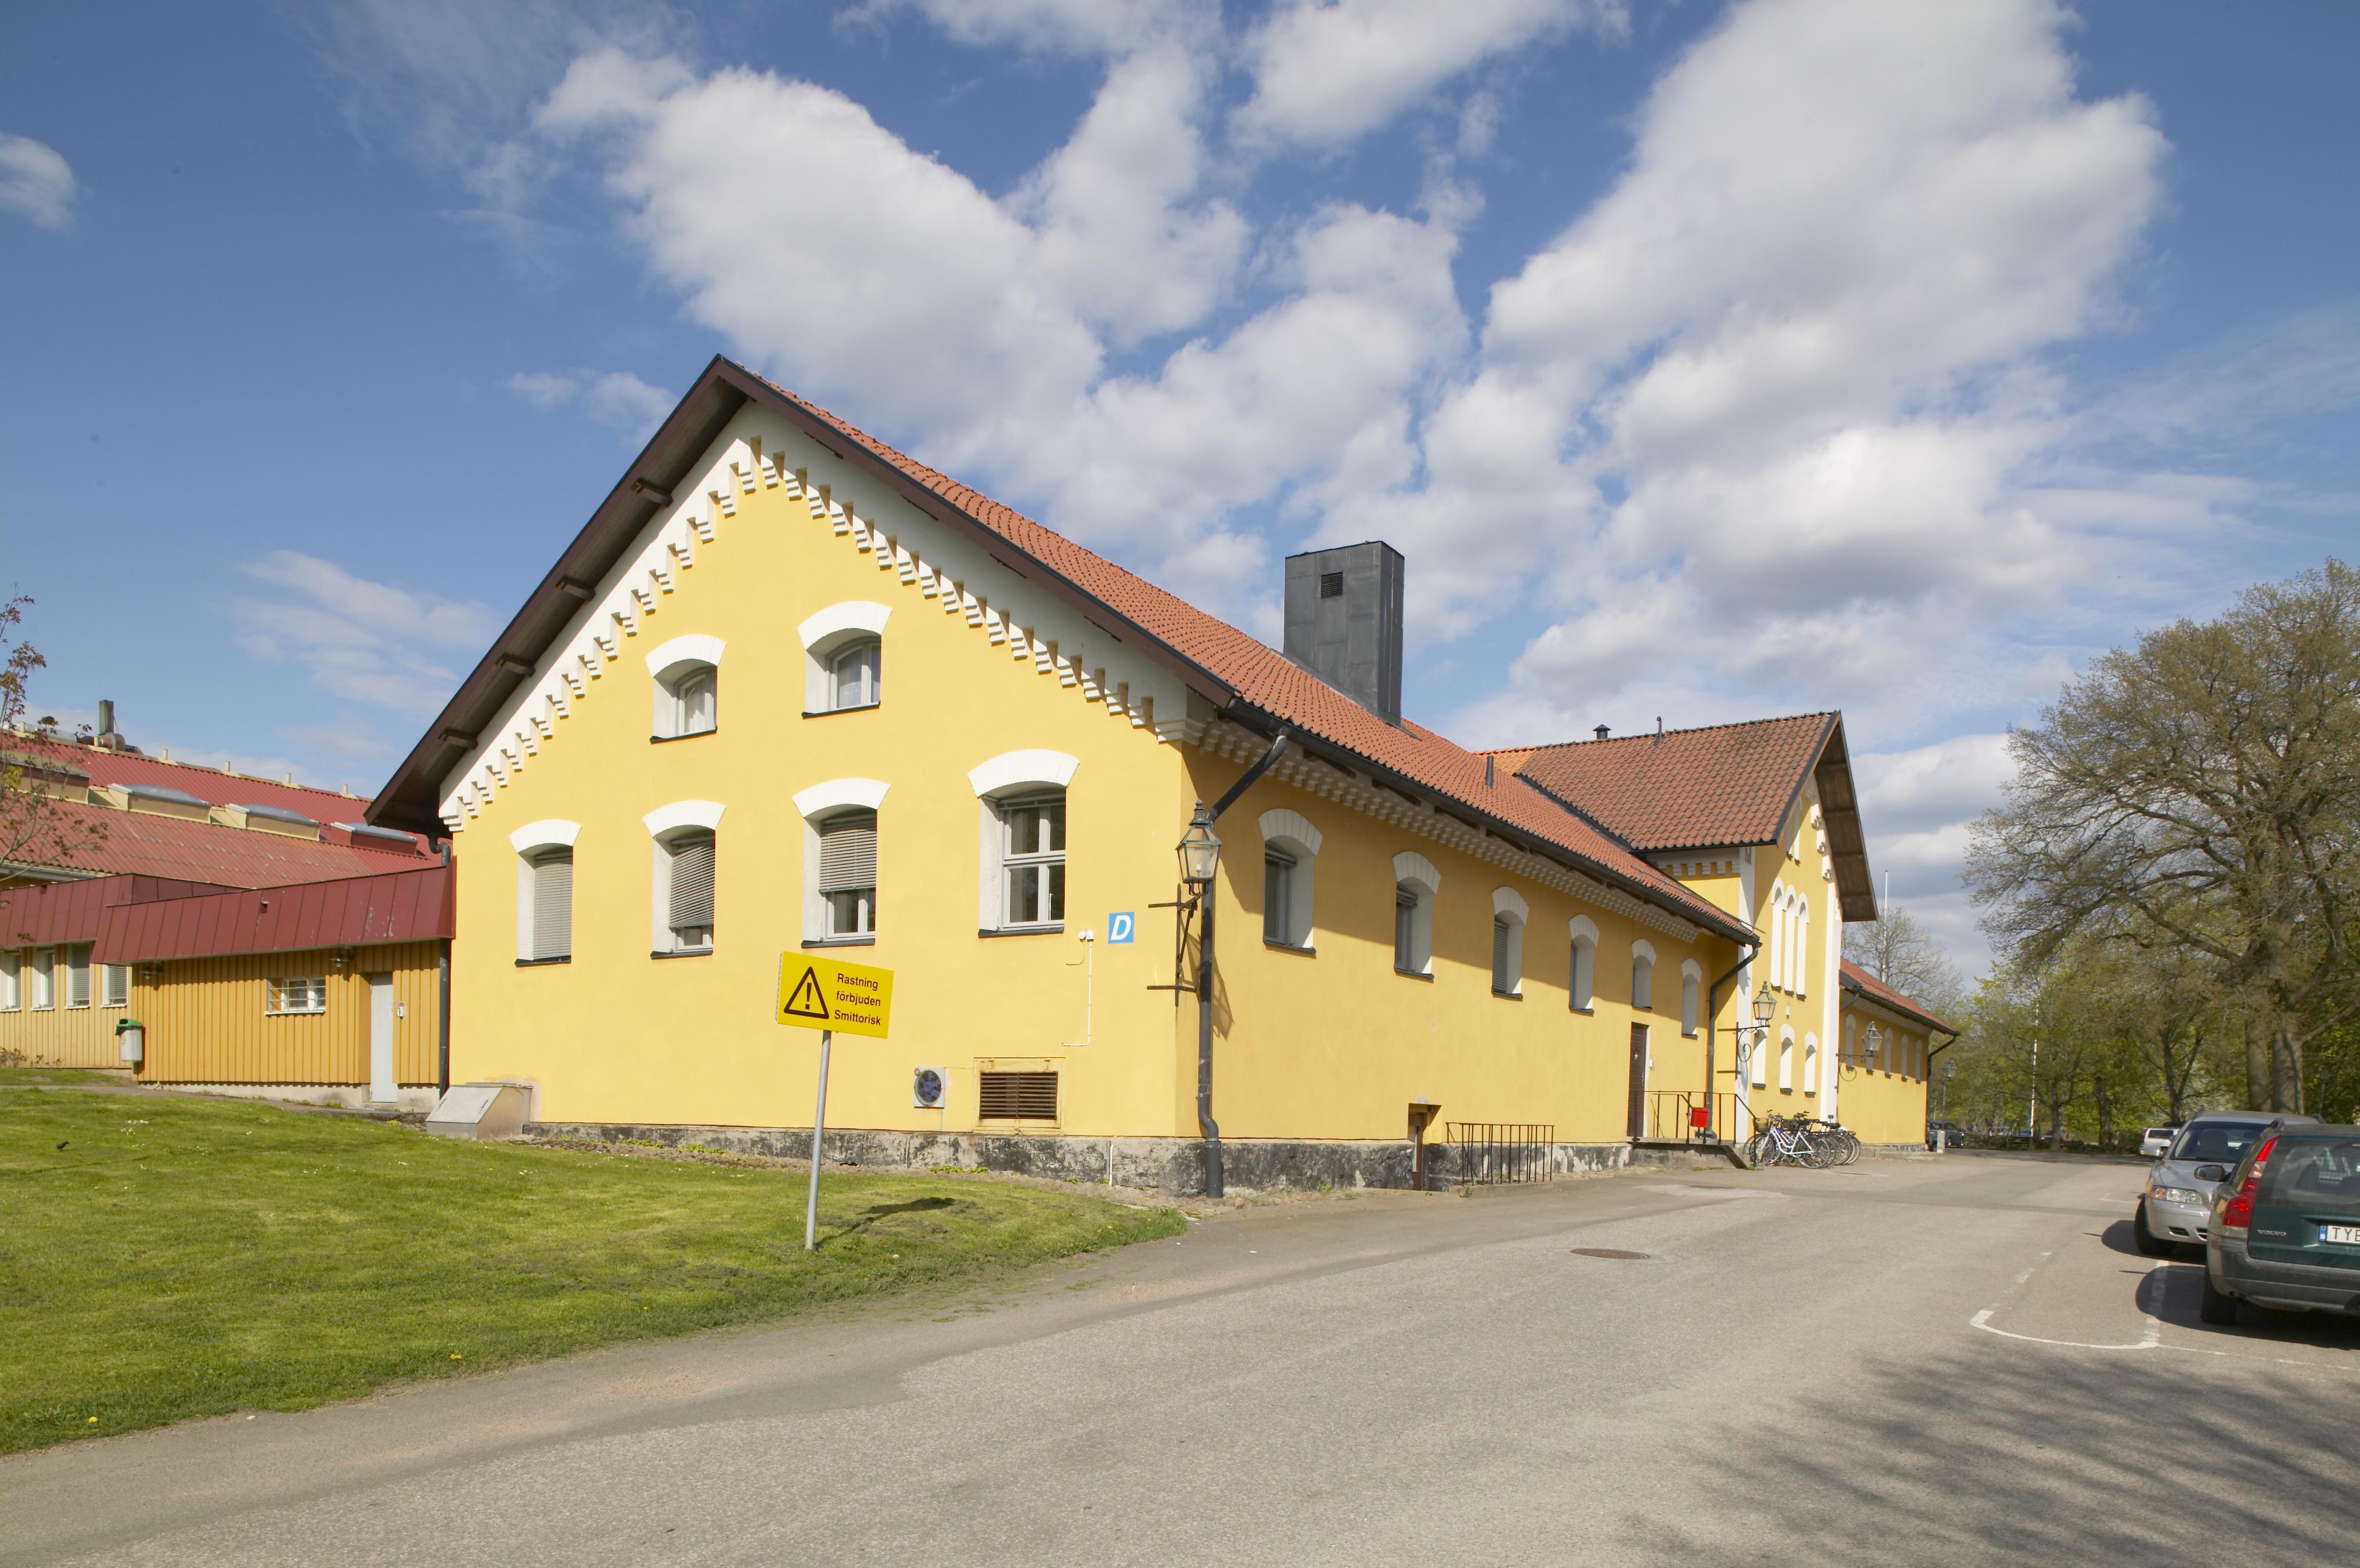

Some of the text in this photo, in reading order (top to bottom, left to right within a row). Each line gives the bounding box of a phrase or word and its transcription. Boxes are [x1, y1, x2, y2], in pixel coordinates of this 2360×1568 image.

[1110, 915, 1131, 940] D
[837, 973, 878, 991] Rastning
[836, 991, 880, 1006] förbjuden
[834, 1010, 880, 1025] Smittorisk
